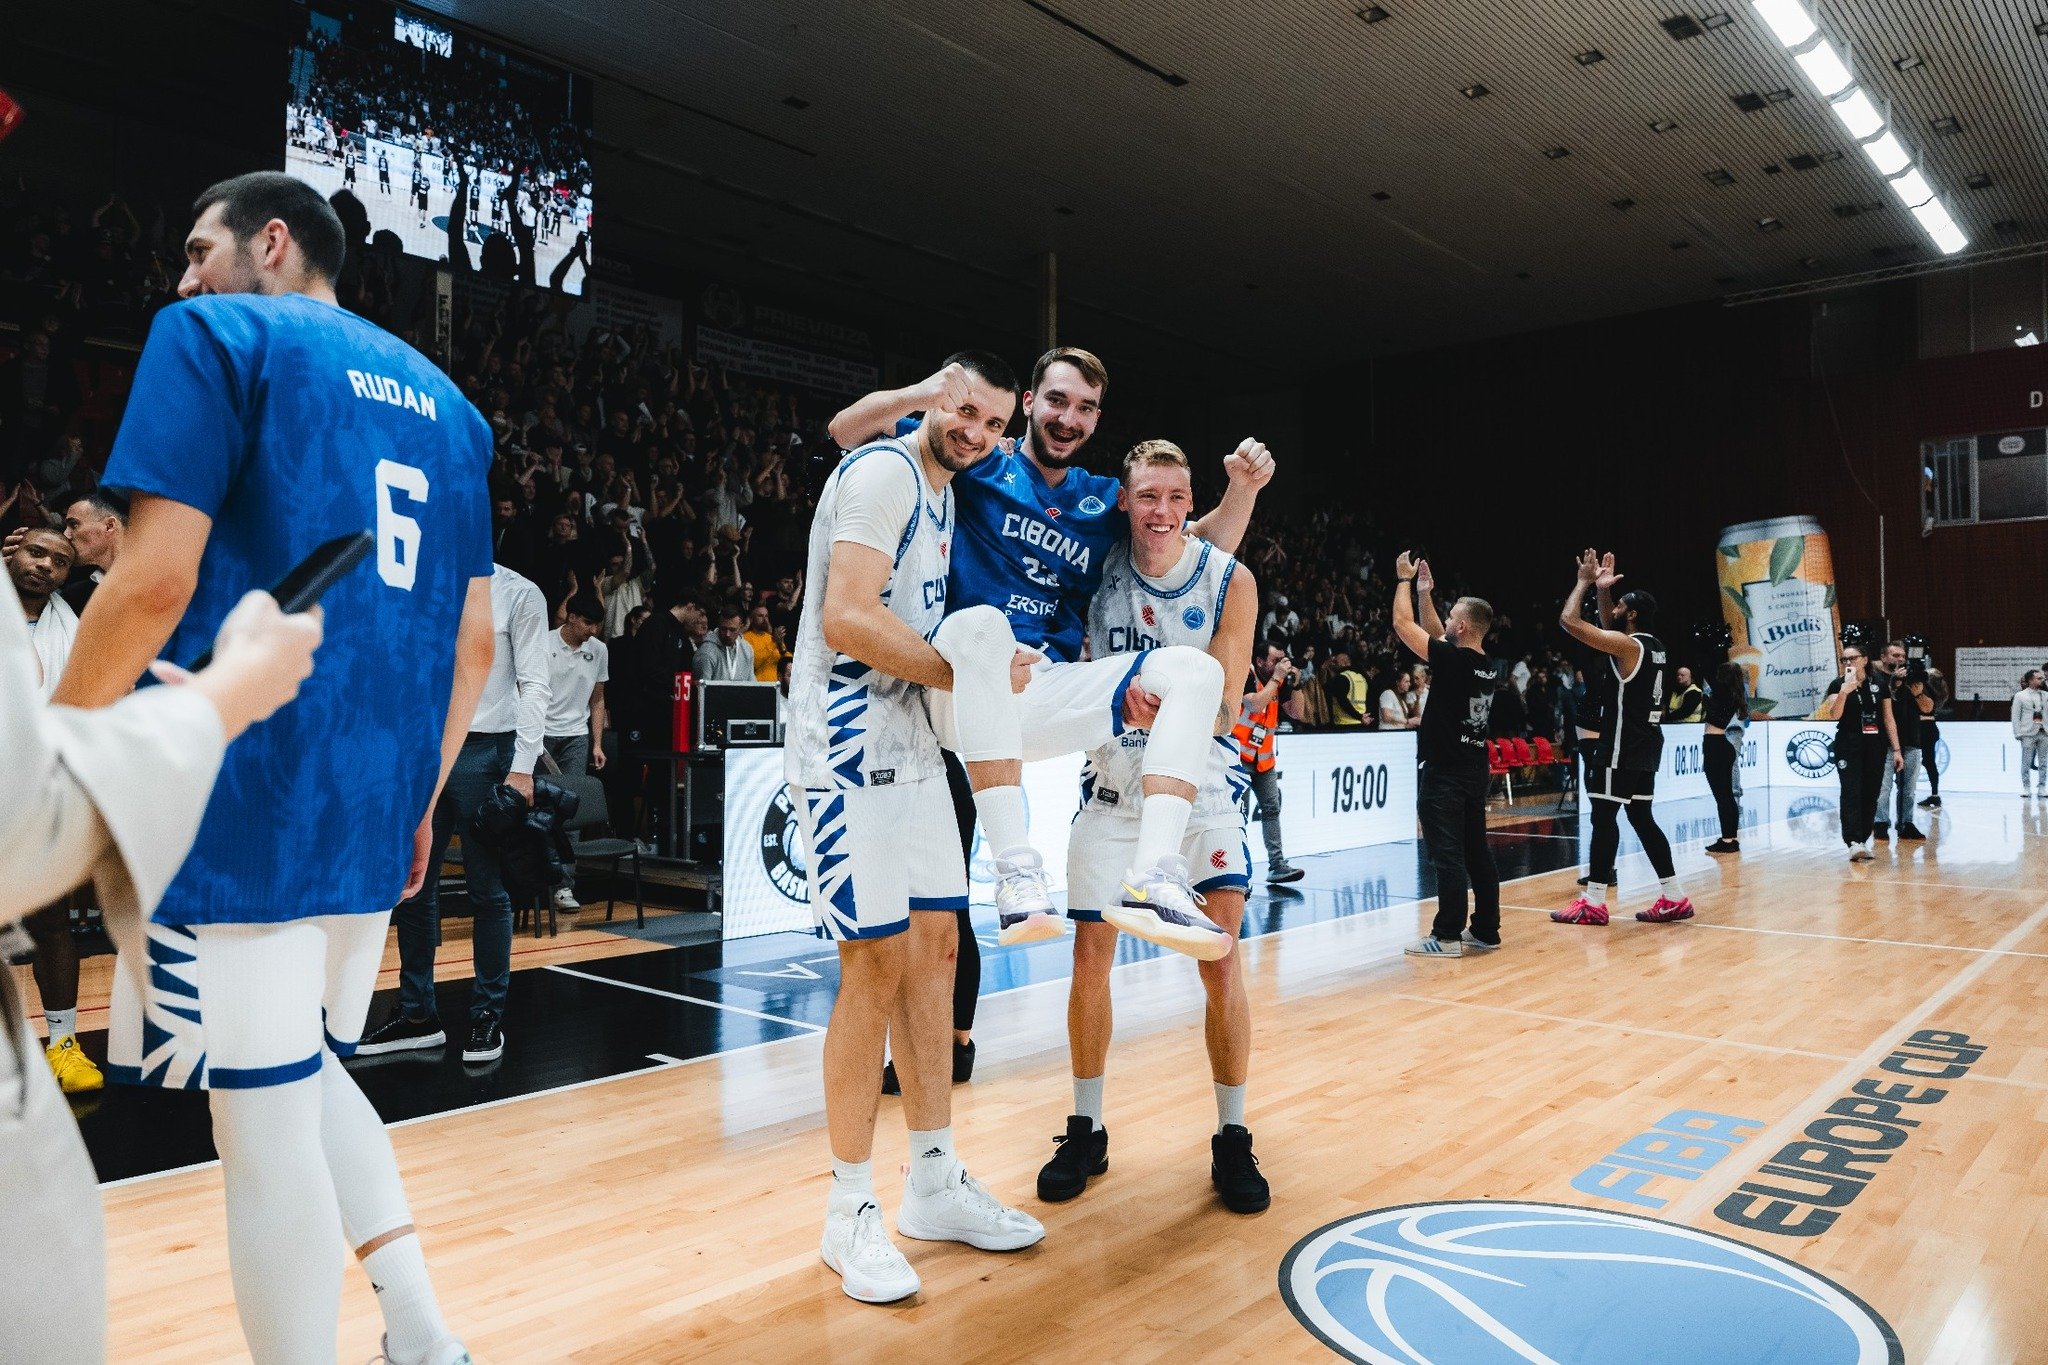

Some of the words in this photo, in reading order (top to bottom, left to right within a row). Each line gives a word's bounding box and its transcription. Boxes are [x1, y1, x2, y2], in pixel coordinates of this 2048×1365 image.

[347, 369, 437, 421] RUDAN
[375, 458, 429, 592] 6
[1001, 512, 1091, 575] CIBONA
[675, 674, 692, 701] 55
[1652, 669, 1663, 706] 4
[1331, 764, 1388, 813] 19:00
[1570, 1108, 1766, 1210] FIBA
[1713, 1077, 1950, 1239] EUROPE
[1878, 1029, 1989, 1080] CUP
